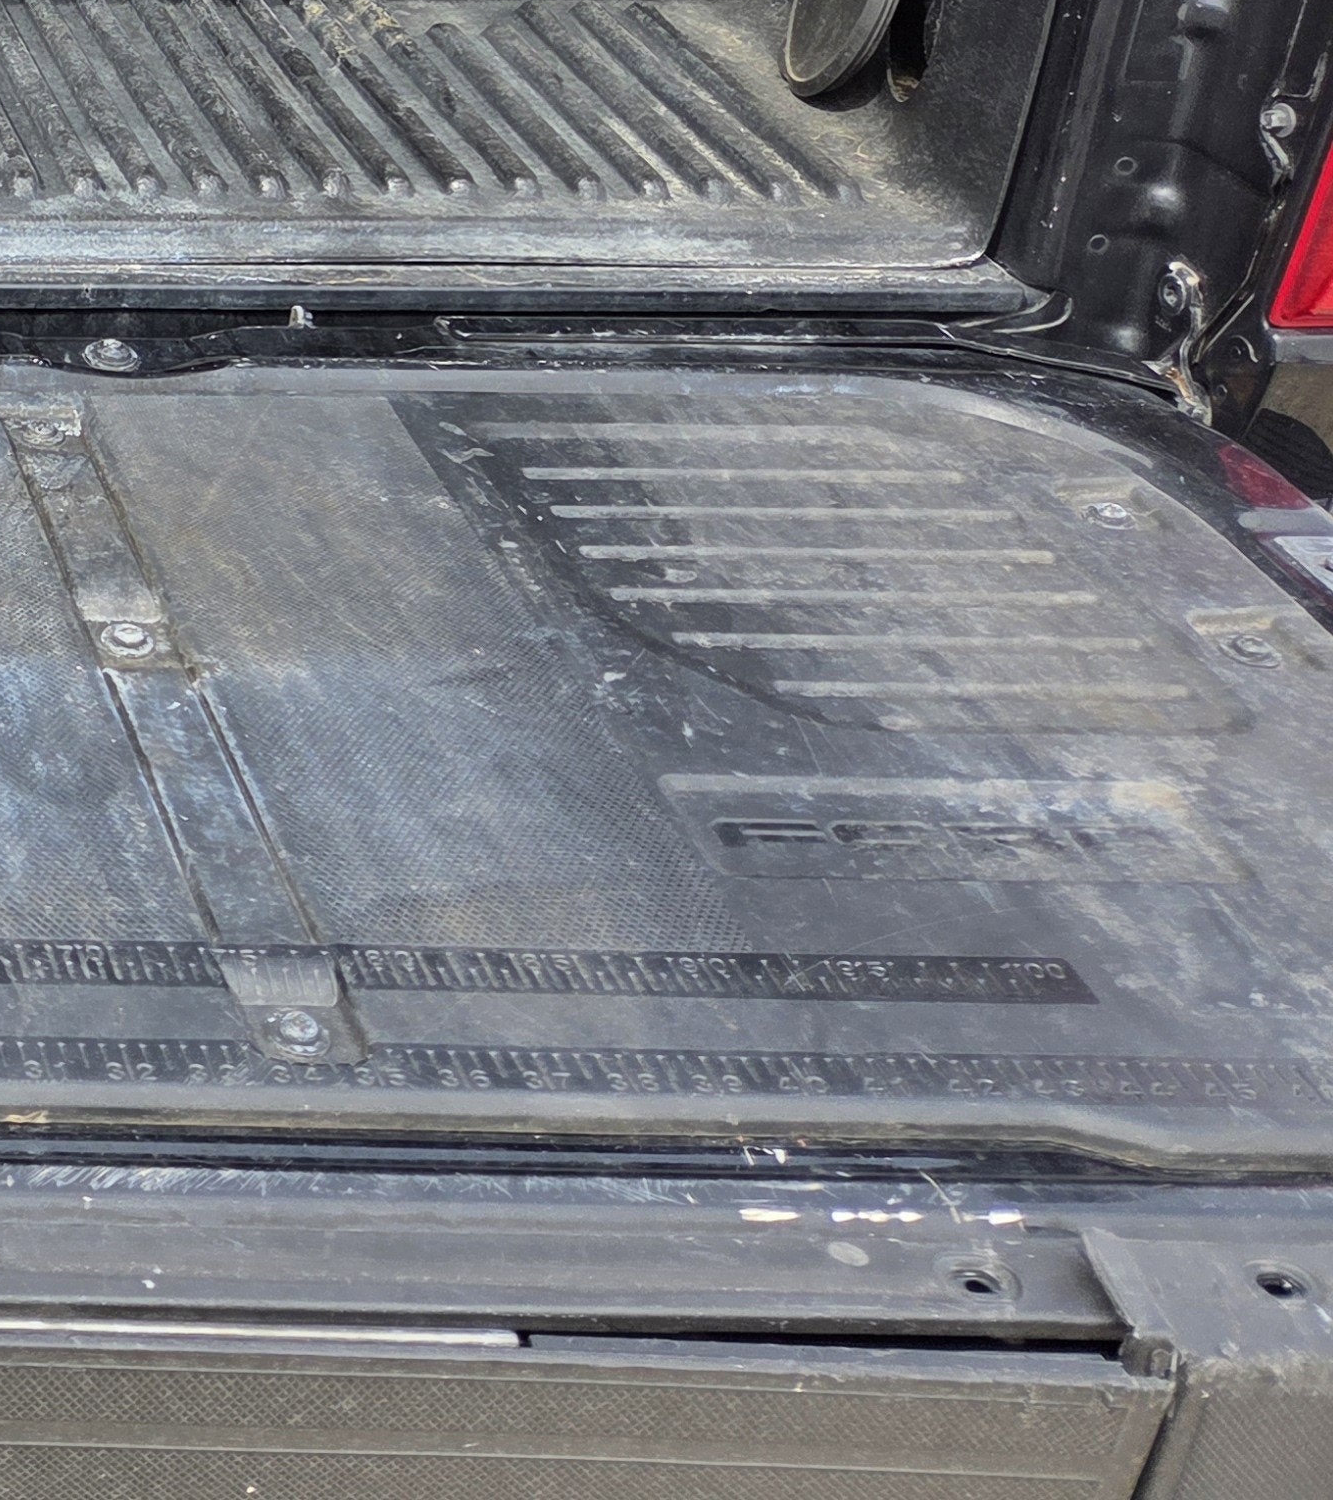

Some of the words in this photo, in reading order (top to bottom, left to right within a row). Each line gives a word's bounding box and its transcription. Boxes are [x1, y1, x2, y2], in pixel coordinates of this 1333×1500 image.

[106, 1061, 157, 1081] 32
[438, 1068, 491, 1088] 36
[523, 1070, 571, 1089] 37
